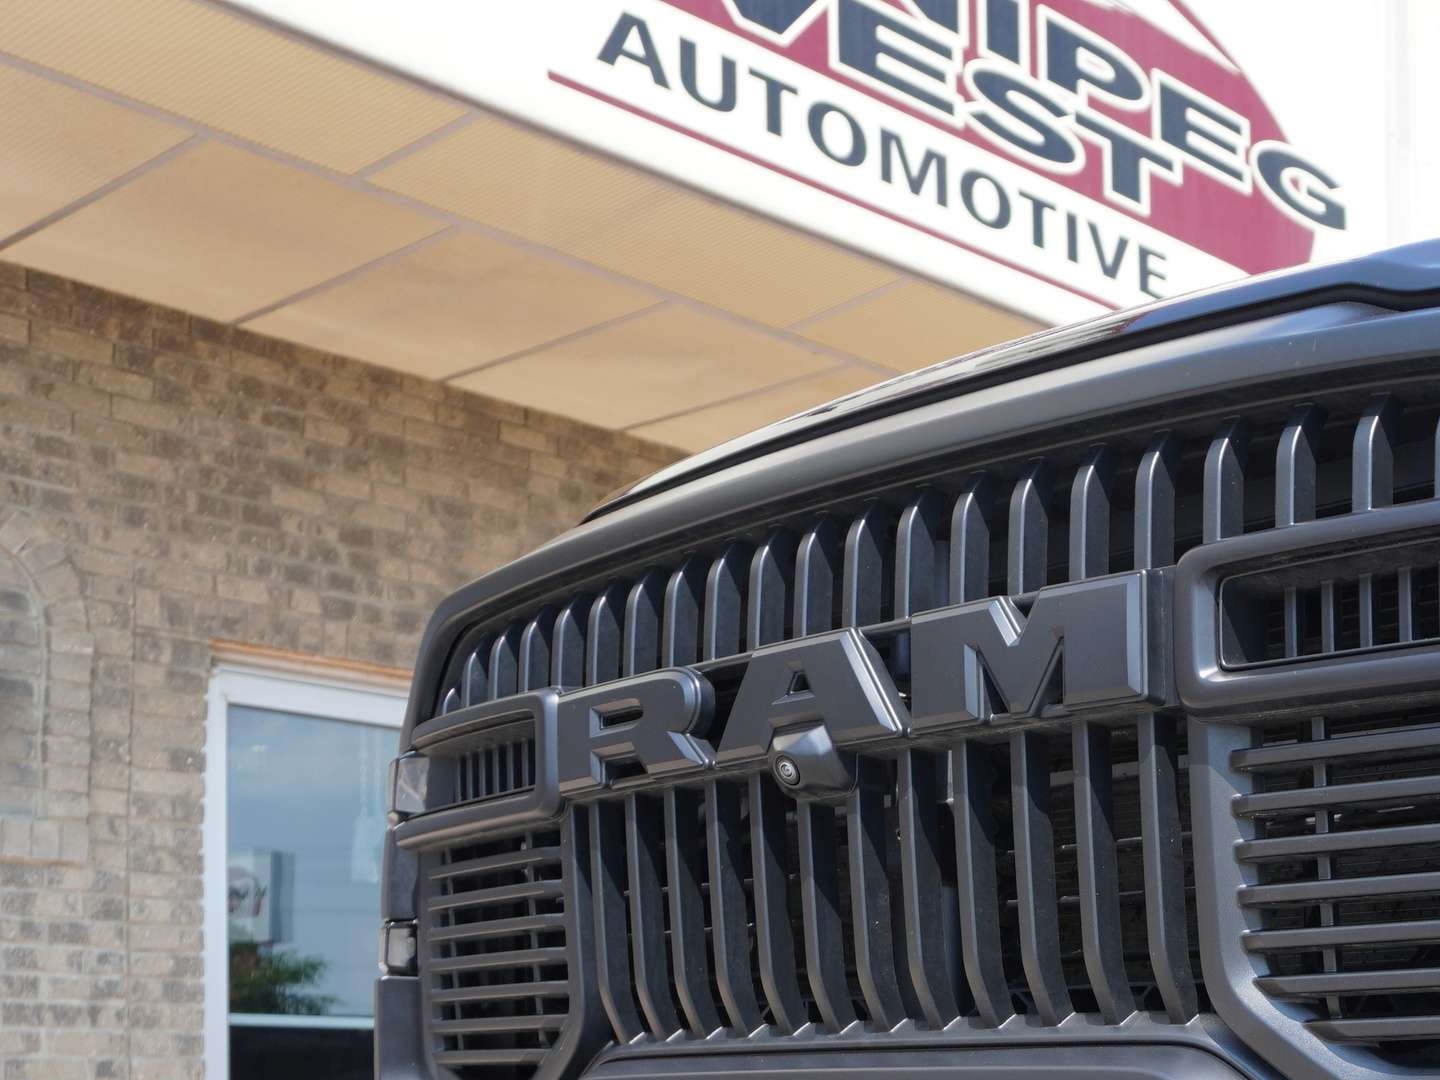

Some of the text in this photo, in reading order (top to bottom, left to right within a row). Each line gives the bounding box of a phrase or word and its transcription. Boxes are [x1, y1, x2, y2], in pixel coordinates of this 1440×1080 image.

[596, 12, 1168, 299] AUTOMOTIVE
[912, 0, 1346, 230] IPEG
[557, 569, 1155, 795] RAM
